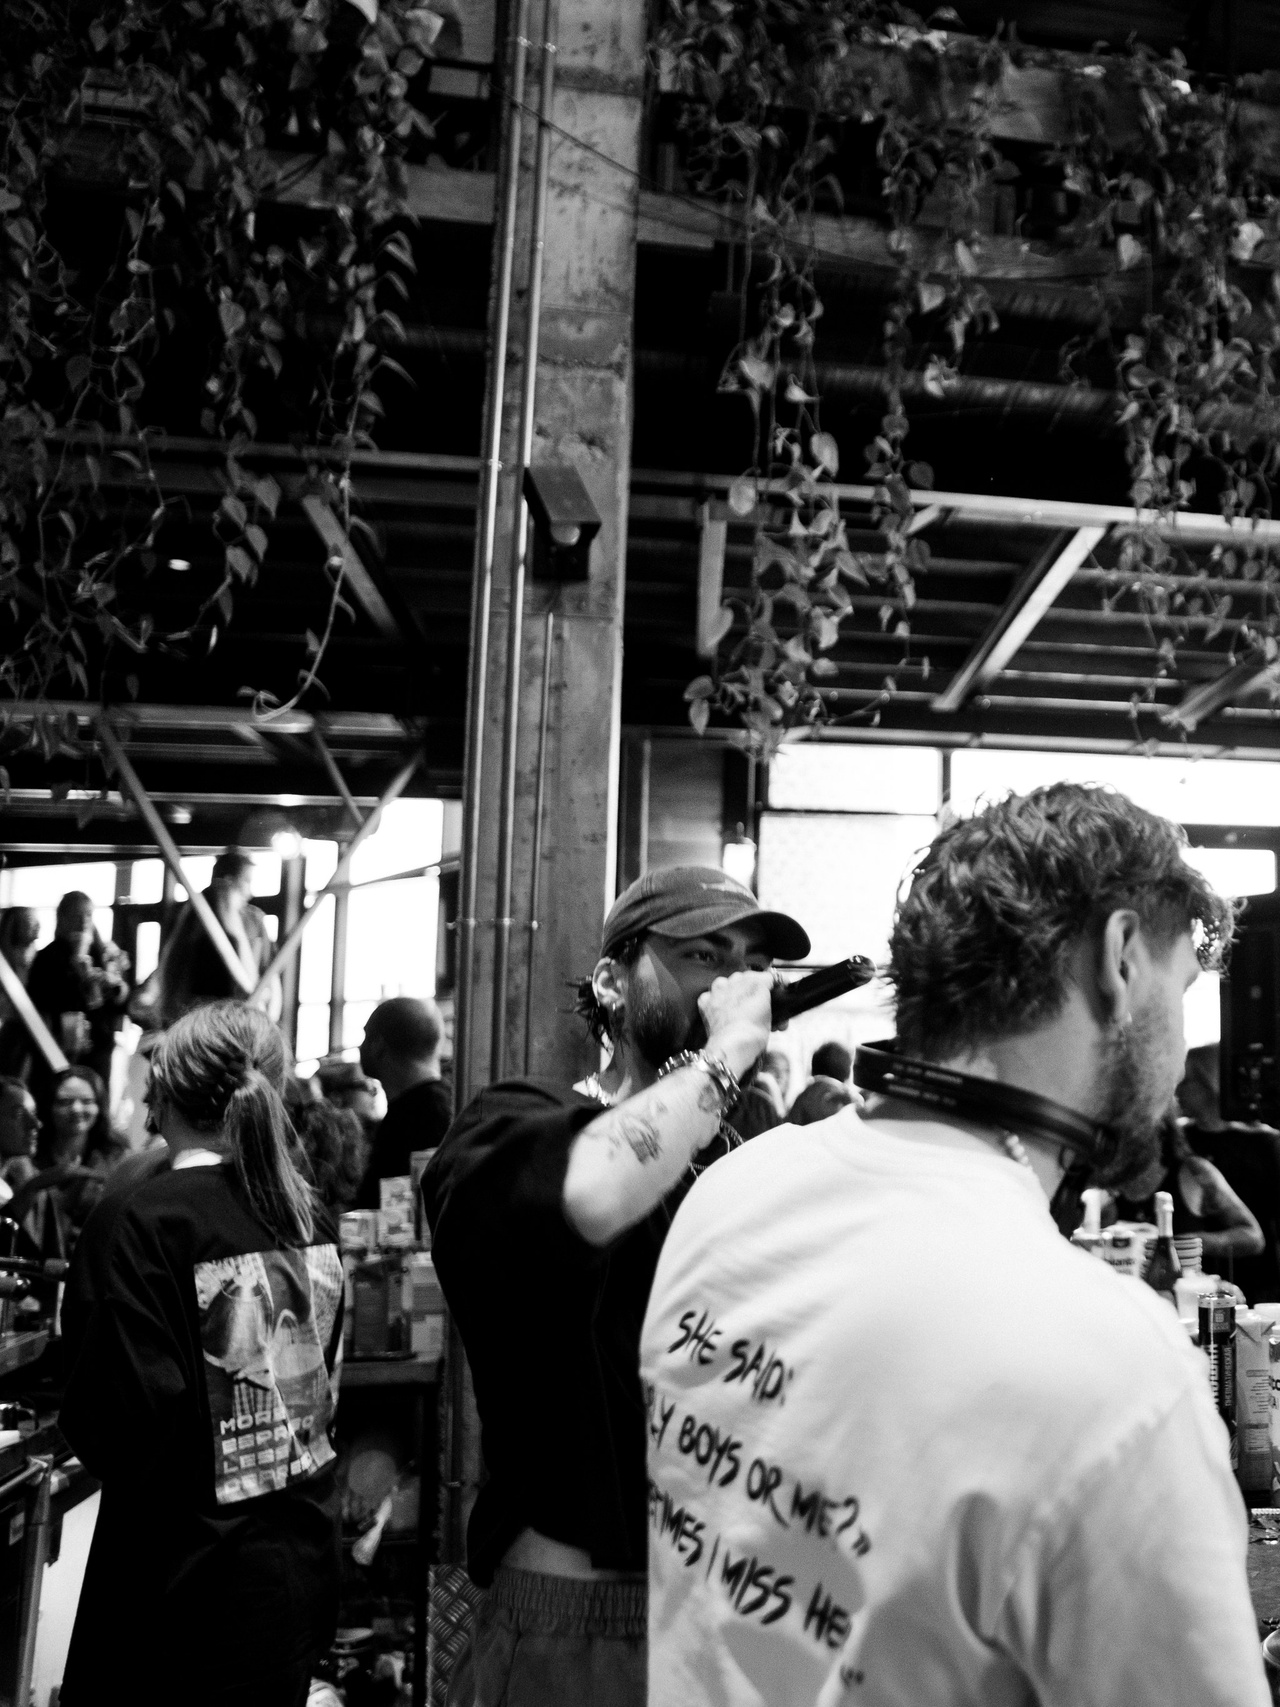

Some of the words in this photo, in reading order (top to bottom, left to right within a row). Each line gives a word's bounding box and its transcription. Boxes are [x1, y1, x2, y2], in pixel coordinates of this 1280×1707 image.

[667, 1308, 723, 1365] SHE
[679, 1413, 743, 1488] BOYS
[747, 1457, 791, 1529] OR
[721, 1548, 796, 1626] MISS
[803, 1580, 853, 1650] HE
